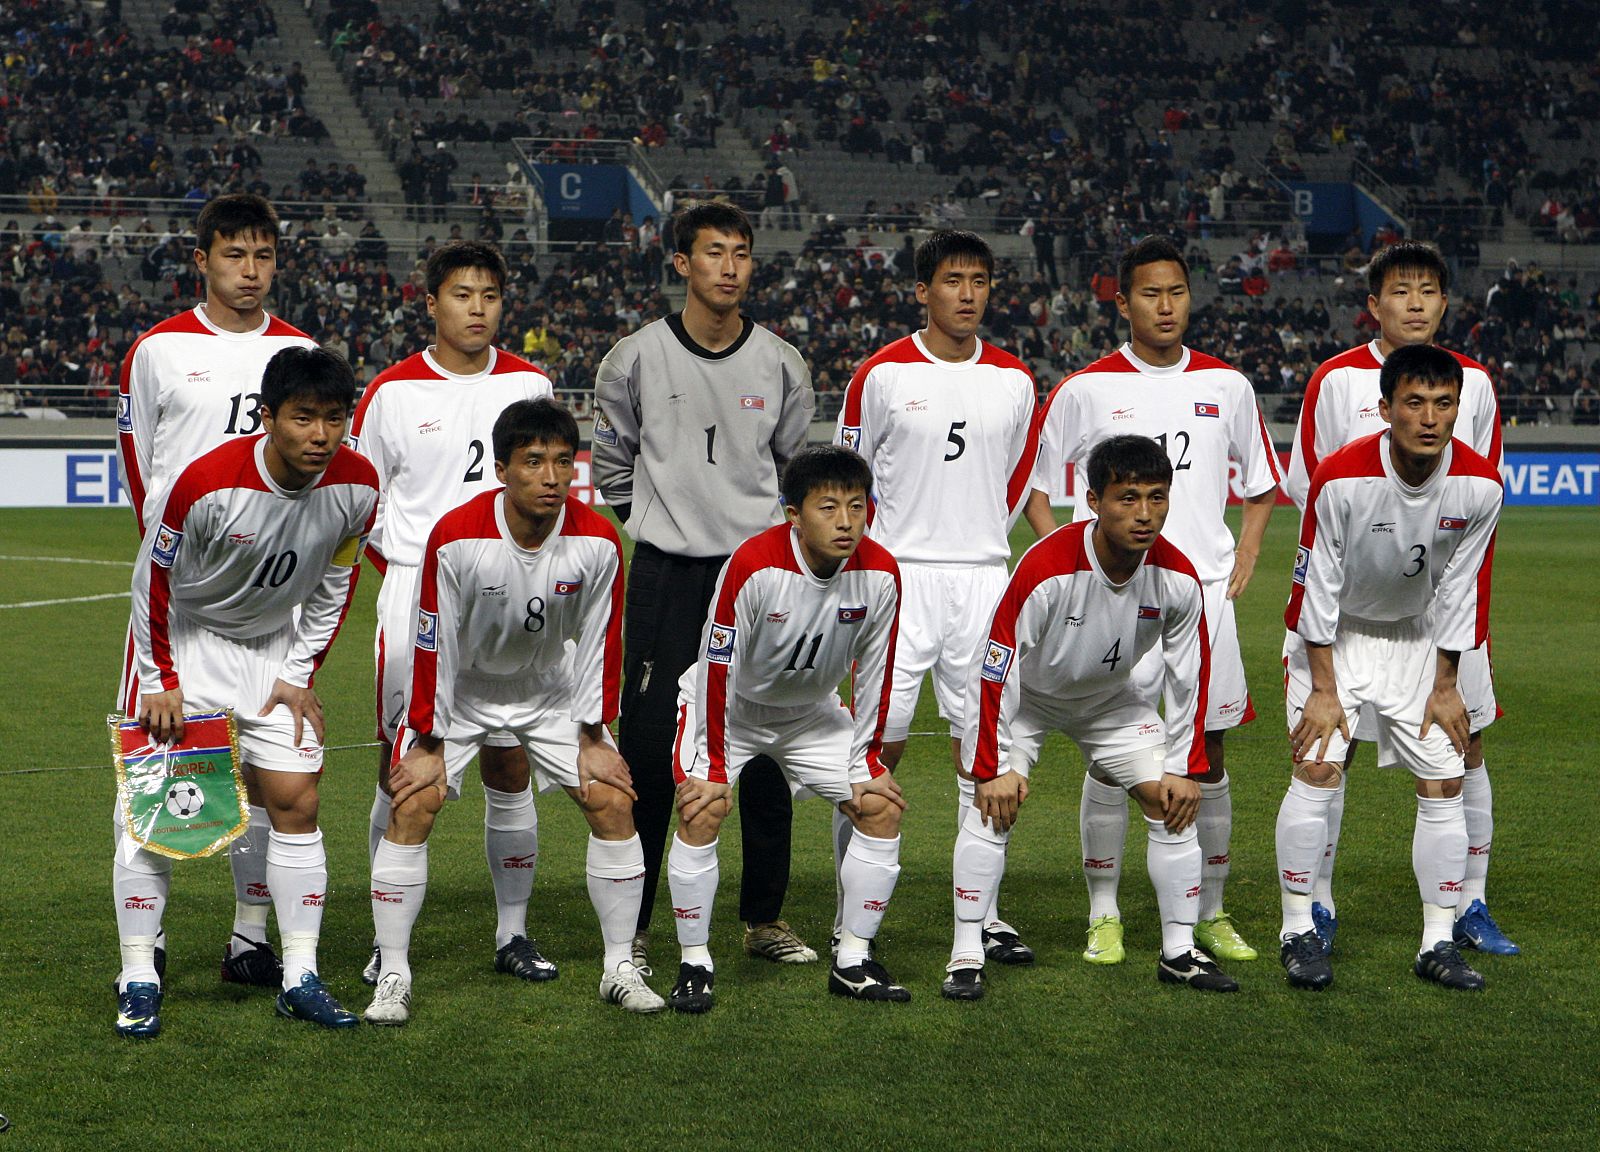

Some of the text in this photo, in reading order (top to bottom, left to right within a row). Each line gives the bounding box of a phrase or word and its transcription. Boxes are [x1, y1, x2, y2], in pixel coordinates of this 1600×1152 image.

[561, 172, 581, 200] C
[1294, 190, 1313, 216] B
[223, 392, 262, 435] 13
[905, 404, 928, 412] ERKE
[1112, 413, 1135, 421] ERKE
[419, 425, 442, 435] ERKE
[704, 424, 717, 466] 1
[943, 420, 967, 462] 5
[463, 439, 485, 483] 2
[252, 550, 298, 589] 10
[1403, 543, 1427, 578] 3
[524, 596, 545, 633] 8
[783, 633, 824, 672] 11
[1101, 637, 1121, 672] 4
[503, 861, 534, 869] ERKE
[1084, 861, 1114, 869] ERKE
[1283, 873, 1309, 884] ERKE
[125, 901, 156, 911] ERKE
